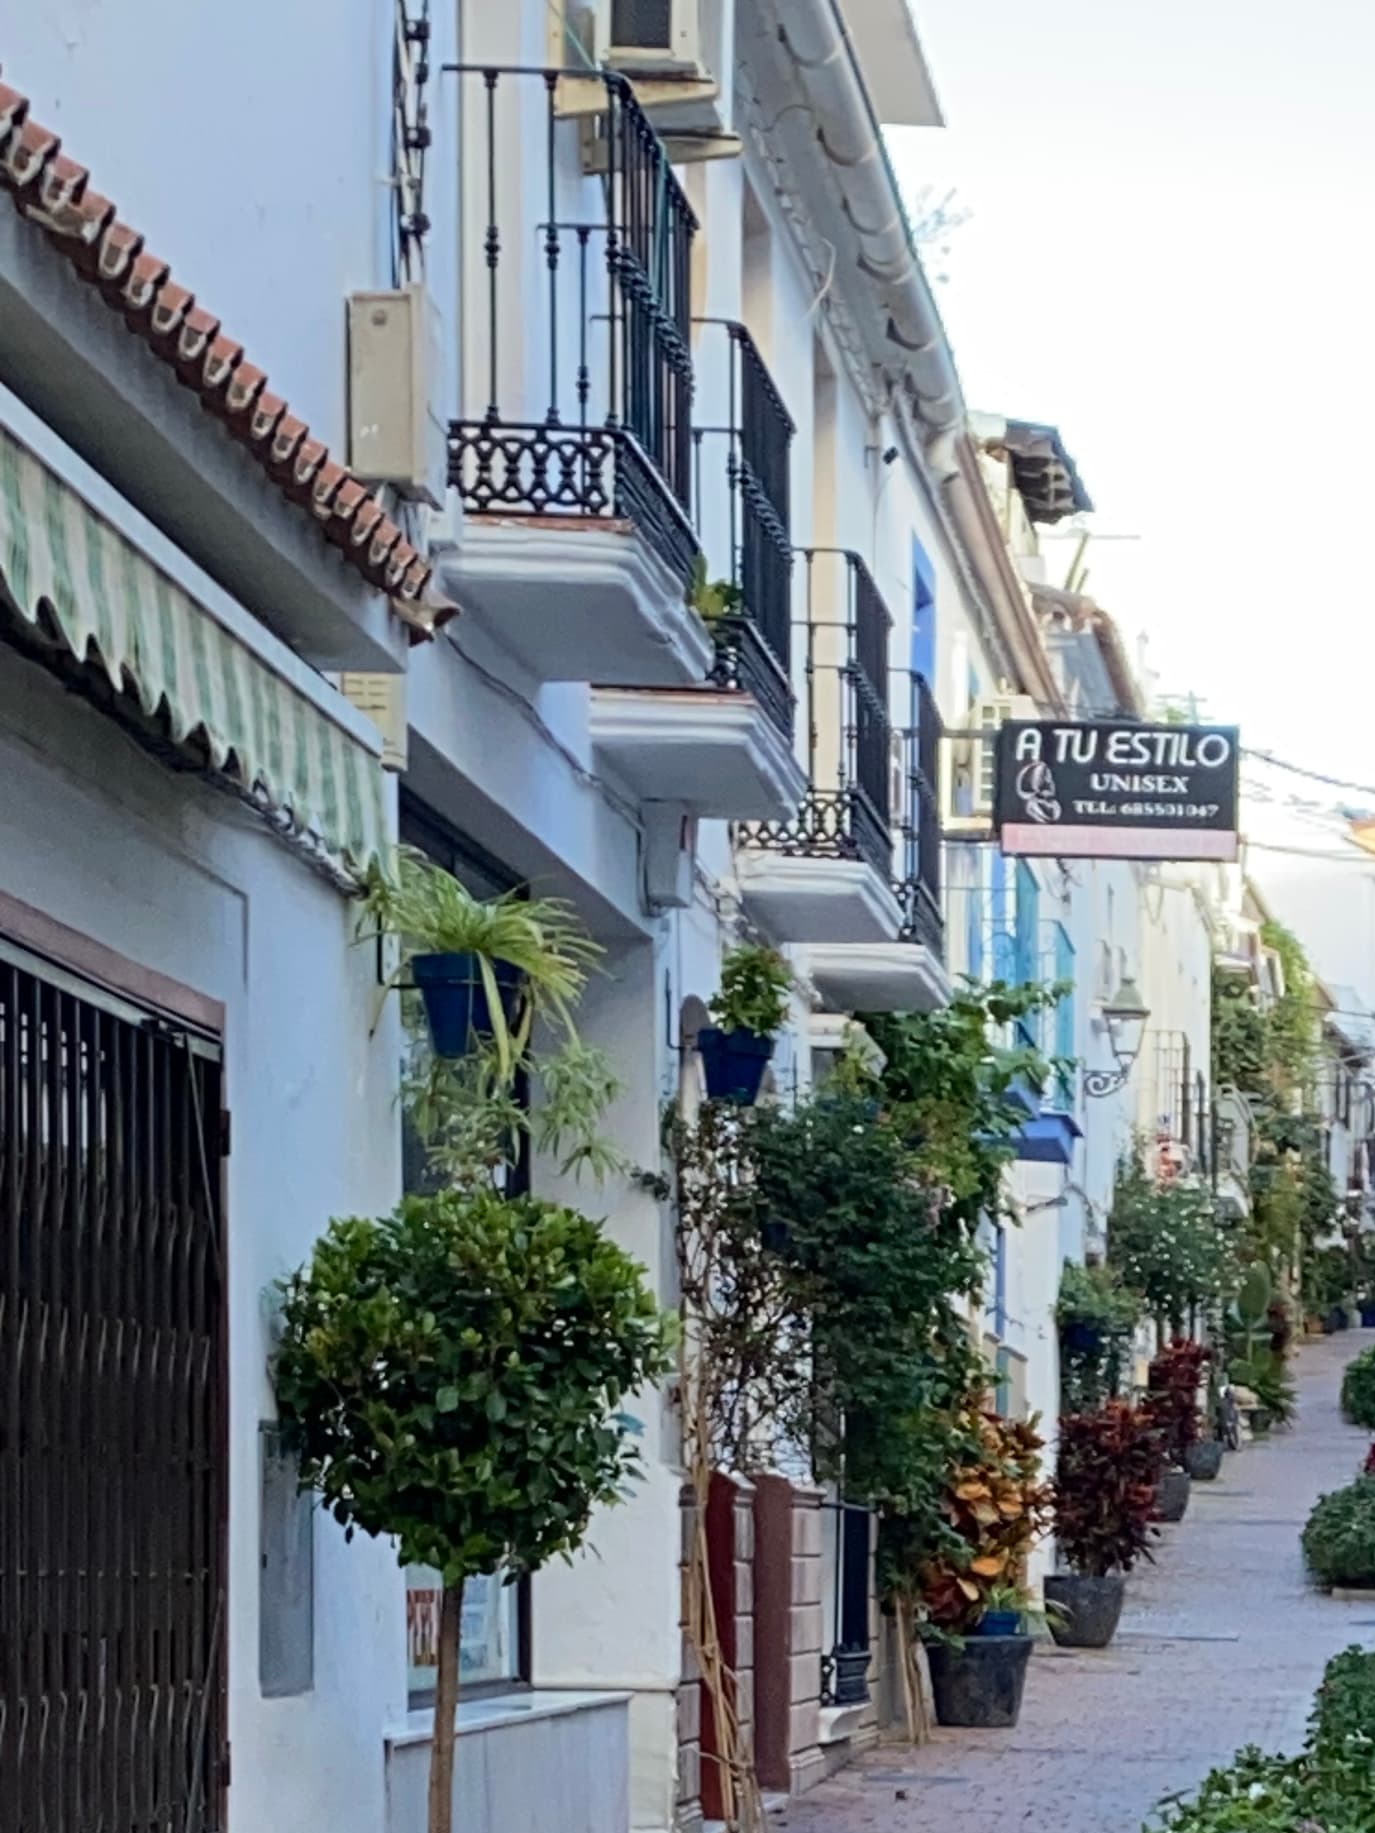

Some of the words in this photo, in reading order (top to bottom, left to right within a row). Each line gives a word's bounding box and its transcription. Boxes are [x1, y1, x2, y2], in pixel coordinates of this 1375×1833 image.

[1015, 728, 1043, 761] A
[1052, 728, 1098, 763] TU
[1105, 730, 1230, 768] ESTILO
[1089, 772, 1190, 793] UNISEX
